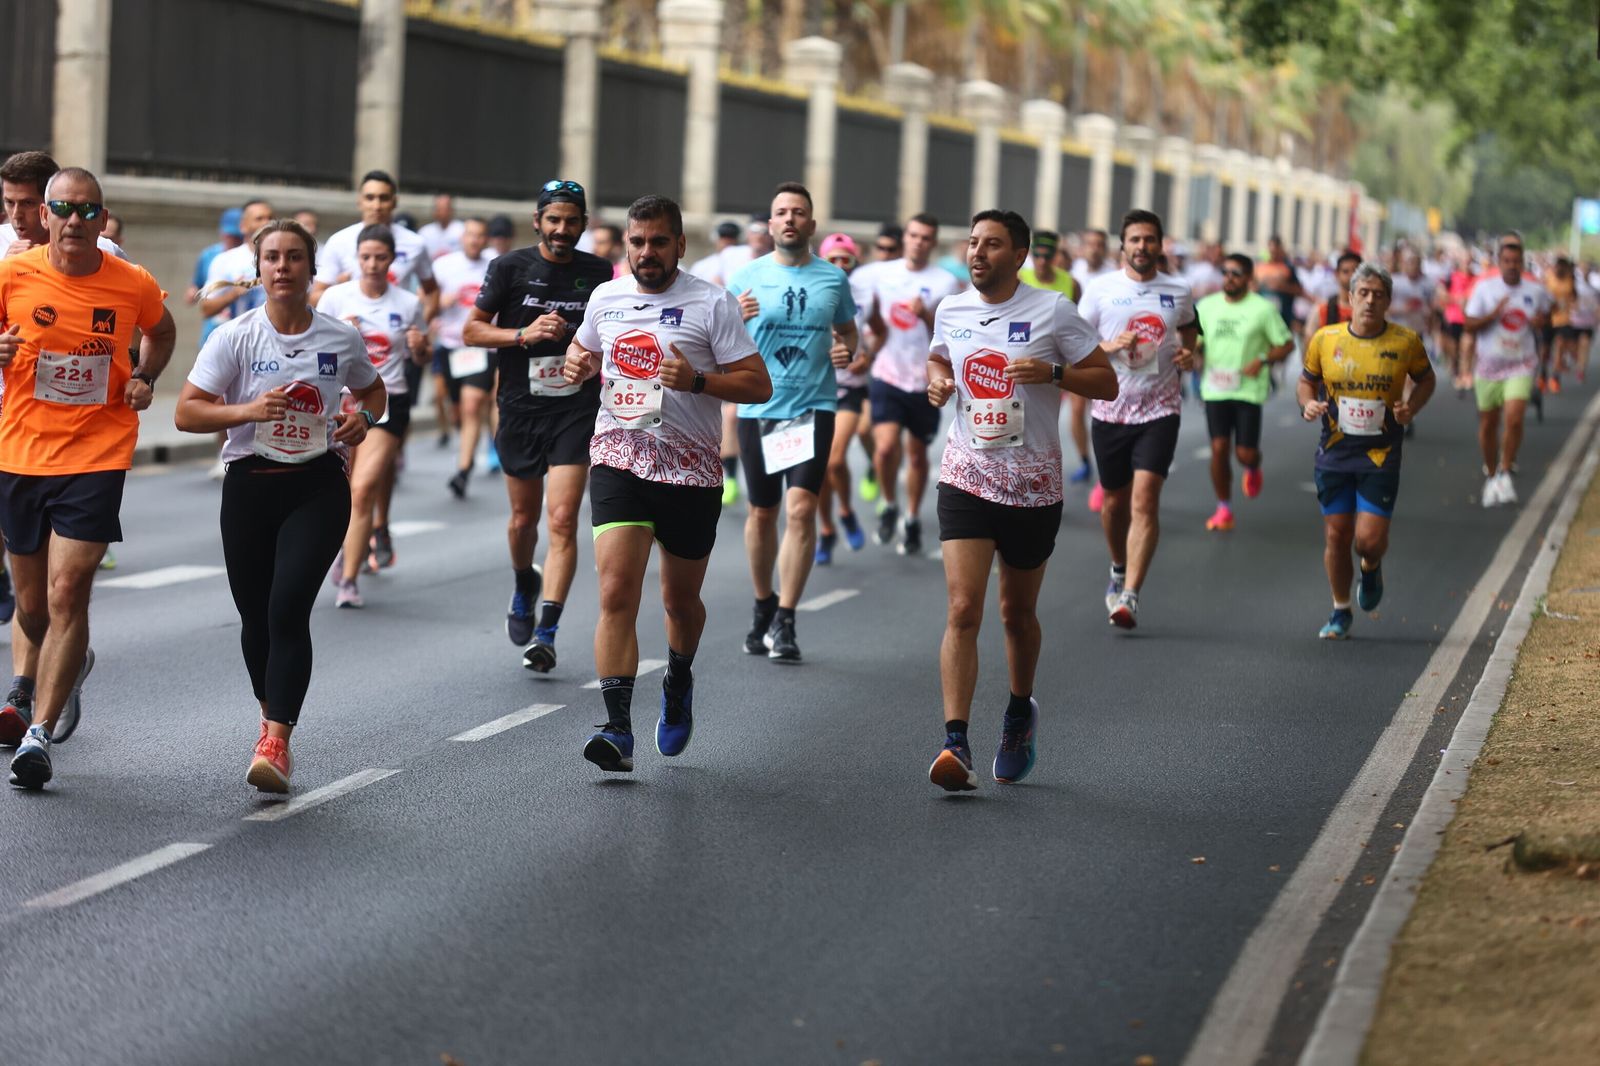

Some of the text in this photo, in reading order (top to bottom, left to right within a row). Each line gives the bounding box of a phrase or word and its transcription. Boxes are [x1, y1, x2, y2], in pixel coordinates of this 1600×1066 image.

[35, 313, 53, 323] FRENO
[36, 308, 55, 319] PONLE
[92, 320, 111, 332] AXA
[1008, 331, 1026, 341] AXA
[619, 342, 657, 362] PONLE
[617, 352, 655, 371] FRENO
[54, 366, 93, 382] 224
[319, 363, 335, 374] AXA
[970, 362, 1009, 382] PONLE
[968, 373, 1008, 392] FRENO
[1347, 381, 1391, 392] SANTO
[614, 392, 647, 405] 367
[1348, 406, 1375, 417] 739
[973, 412, 1008, 425] 648
[272, 423, 310, 440] 225
